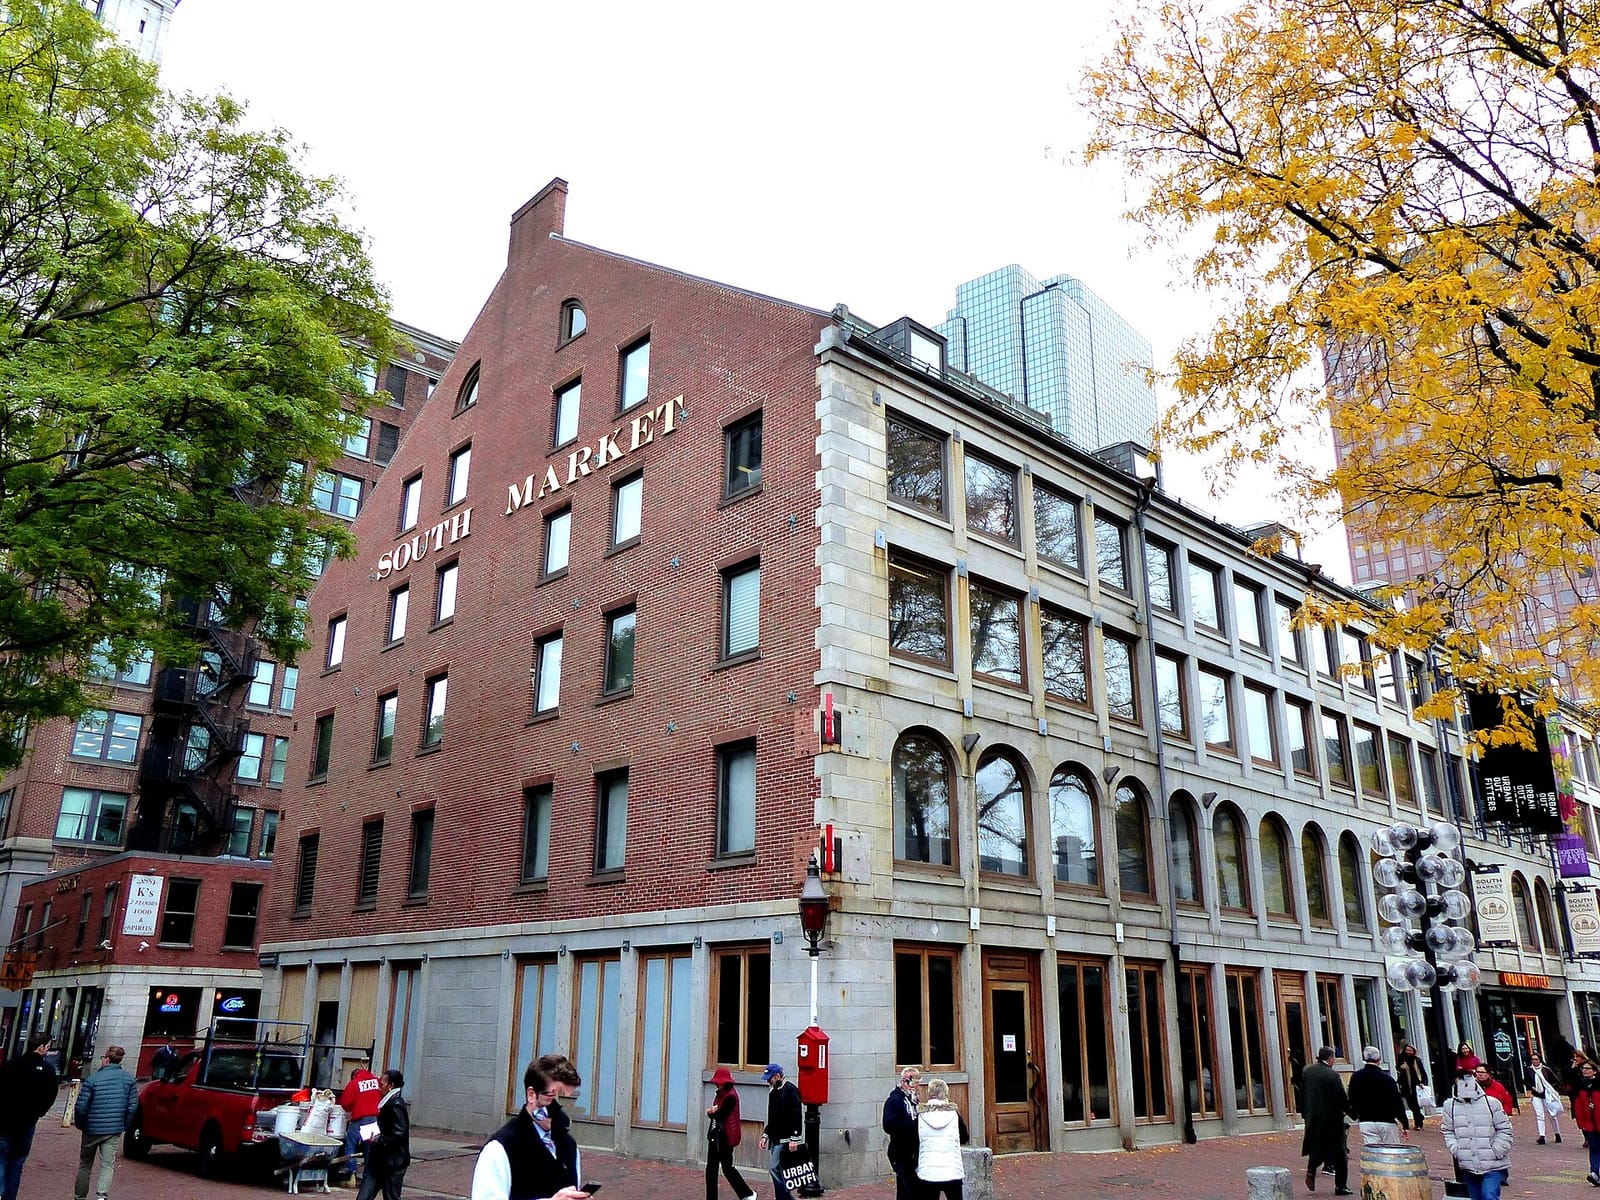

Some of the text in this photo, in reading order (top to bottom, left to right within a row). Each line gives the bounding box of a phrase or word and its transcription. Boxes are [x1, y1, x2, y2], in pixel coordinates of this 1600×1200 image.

[376, 394, 685, 581] SOUTH MARKET
[1484, 777, 1496, 812] FITTERS
[1493, 776, 1503, 797] OUT-
[1501, 775, 1513, 803] URBAN
[1516, 785, 1526, 805] OUT-
[1525, 783, 1536, 810] URBAN
[1539, 792, 1548, 812] OUT-
[1547, 791, 1558, 817] URBAN
[137, 887, 154, 897] K's
[785, 1172, 817, 1190] OUTFI
